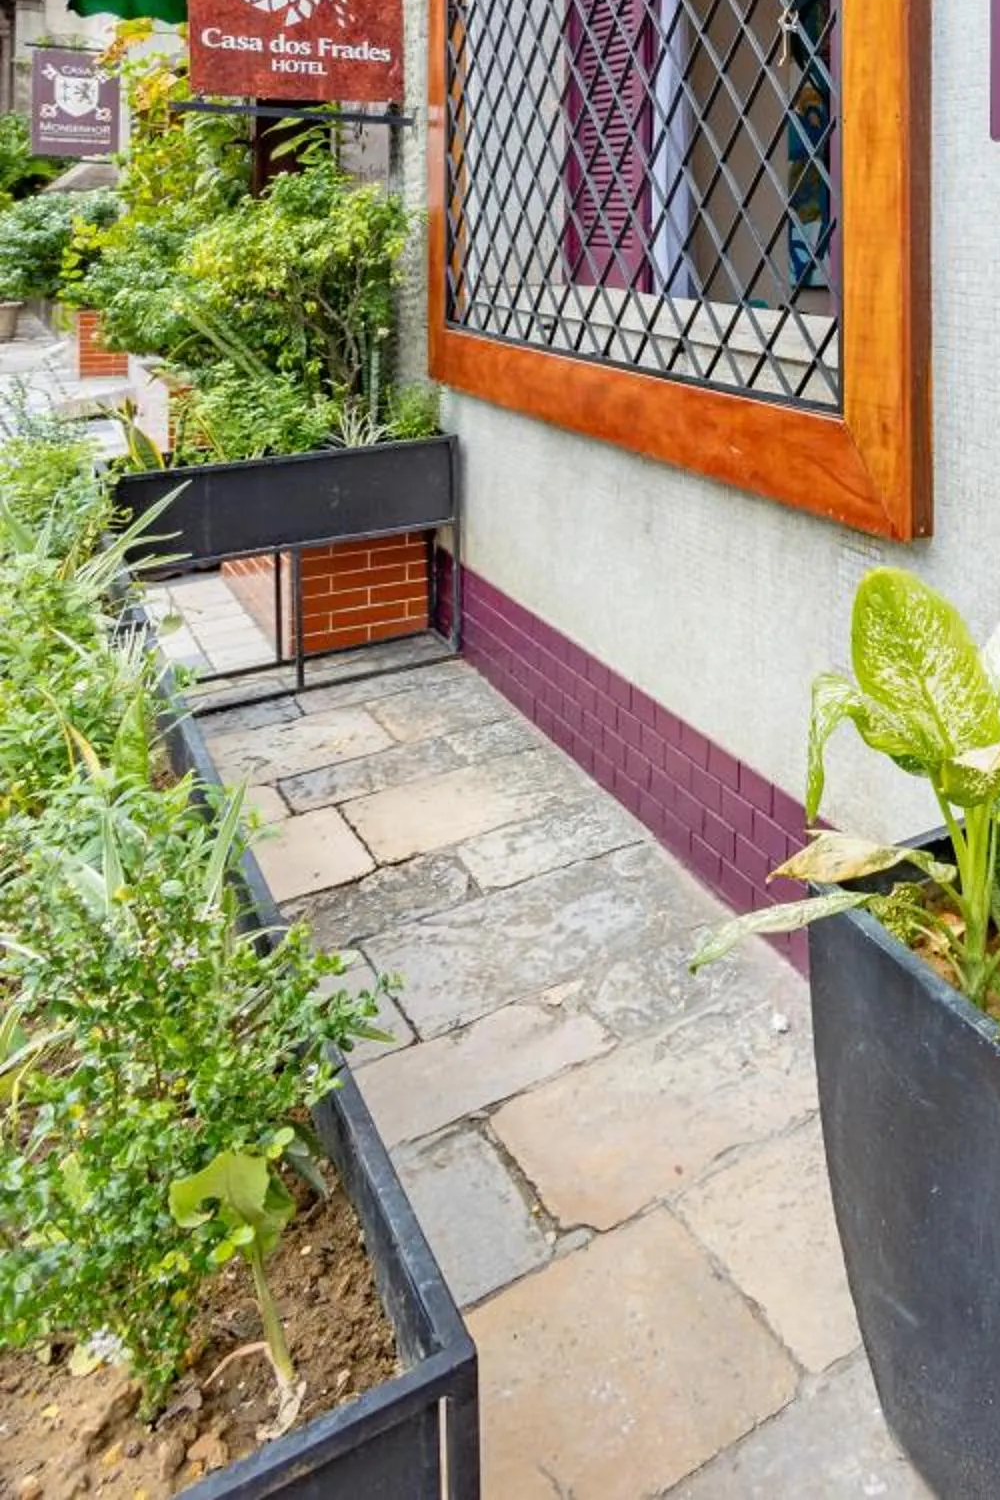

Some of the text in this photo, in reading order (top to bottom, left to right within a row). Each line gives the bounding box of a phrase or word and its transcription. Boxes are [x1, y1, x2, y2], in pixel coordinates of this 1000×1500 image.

[201, 27, 392, 62] Casa dos Frades
[271, 59, 328, 76] HOTEL
